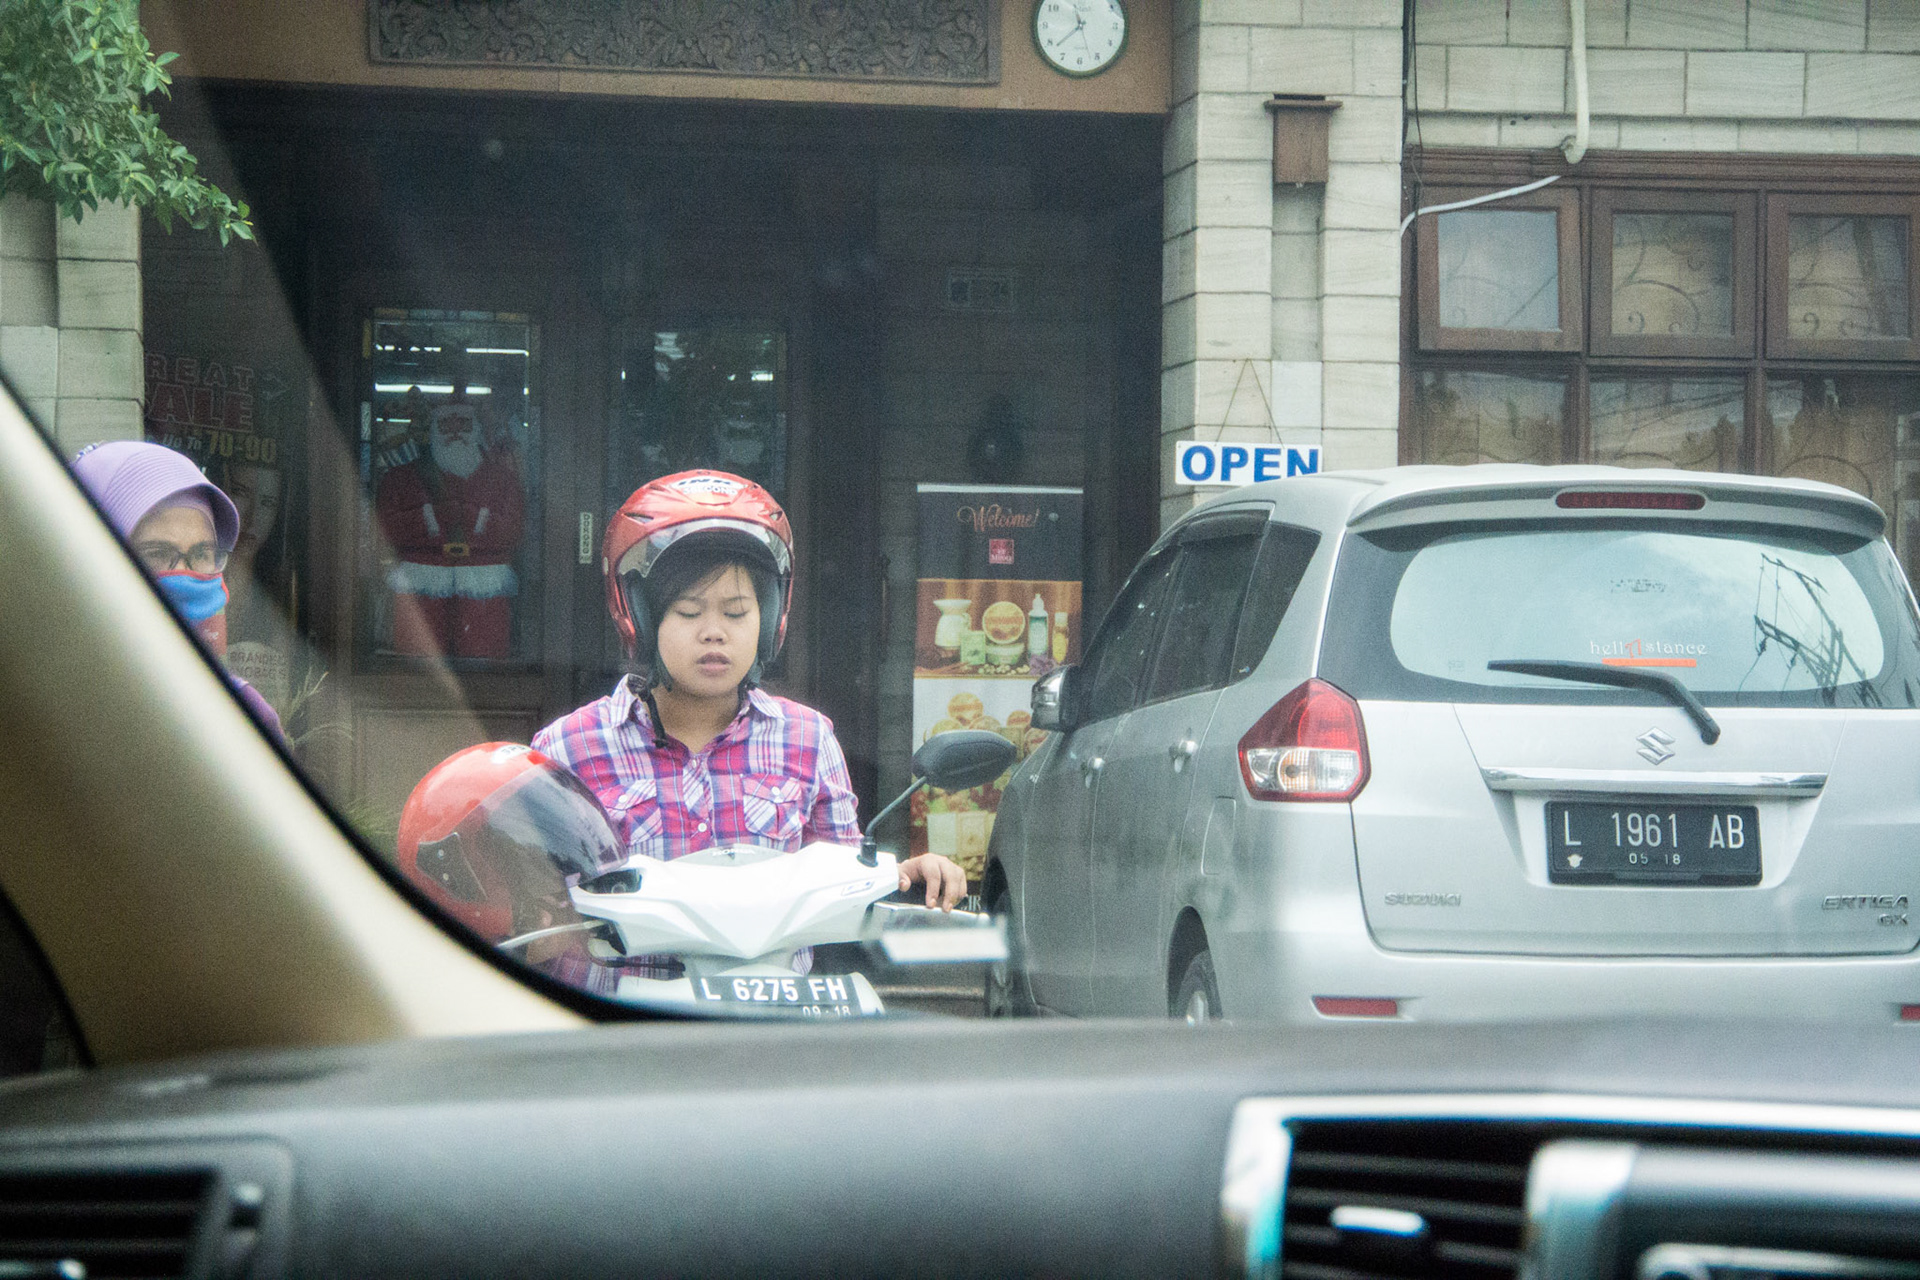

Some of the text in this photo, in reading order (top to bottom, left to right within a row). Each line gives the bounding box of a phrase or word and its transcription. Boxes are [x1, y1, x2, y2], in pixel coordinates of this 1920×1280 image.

[145, 354, 254, 391] REAT
[1181, 445, 1319, 482] OPEN
[956, 503, 1040, 532] Welcome!
[1564, 810, 1744, 849] L 1961 AB
[1628, 853, 1681, 865] 05 18
[1384, 892, 1461, 907] SUZUKI
[1821, 894, 1909, 911] ERTIGA
[1877, 913, 1908, 927] GX
[700, 978, 849, 1002] L 6275 FH
